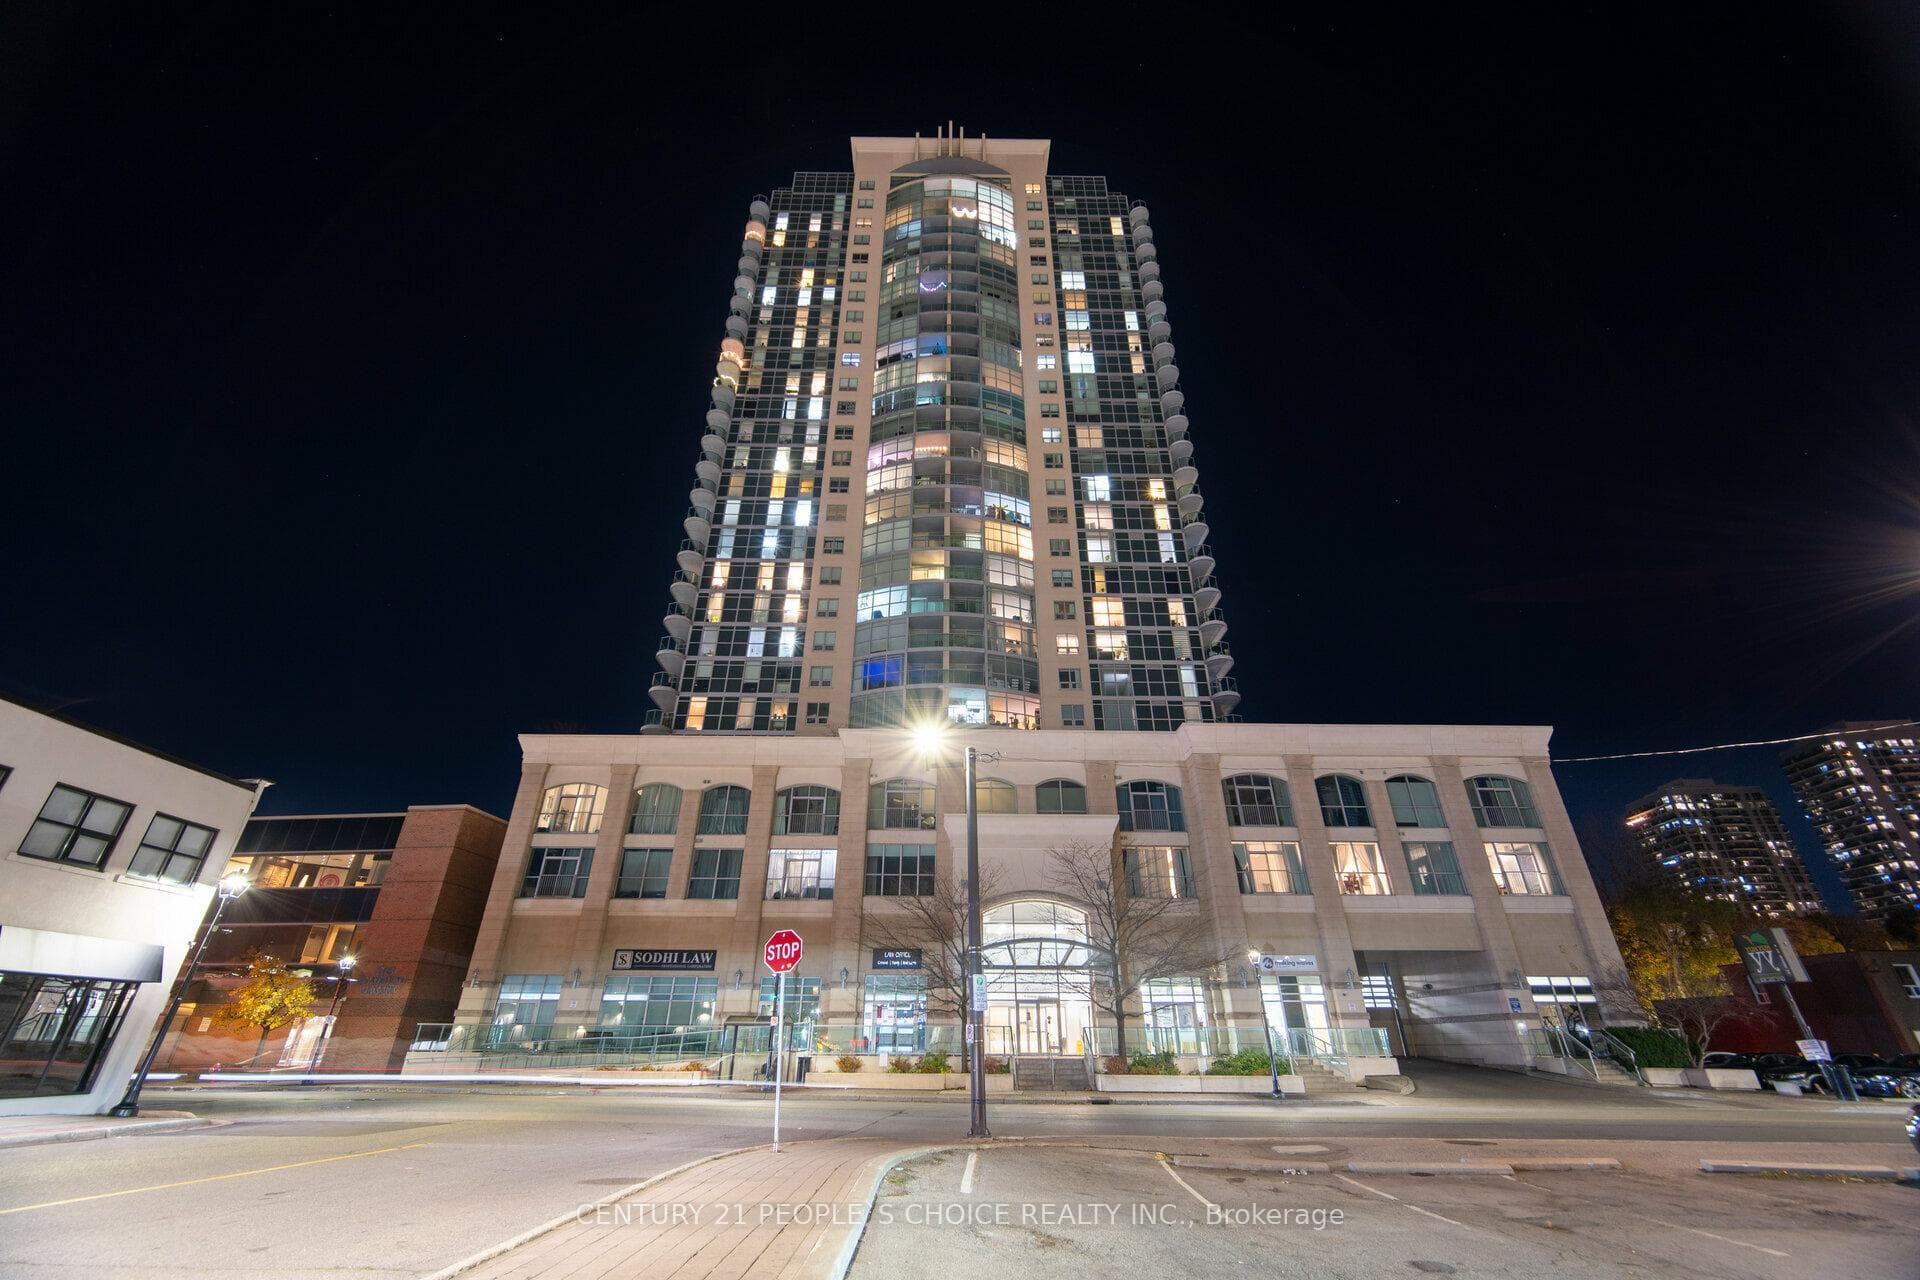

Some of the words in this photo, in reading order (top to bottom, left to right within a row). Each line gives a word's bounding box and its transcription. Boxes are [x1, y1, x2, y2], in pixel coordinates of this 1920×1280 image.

[634, 952, 679, 964] SODHI
[682, 952, 714, 964] LAW
[767, 942, 800, 961] STOP
